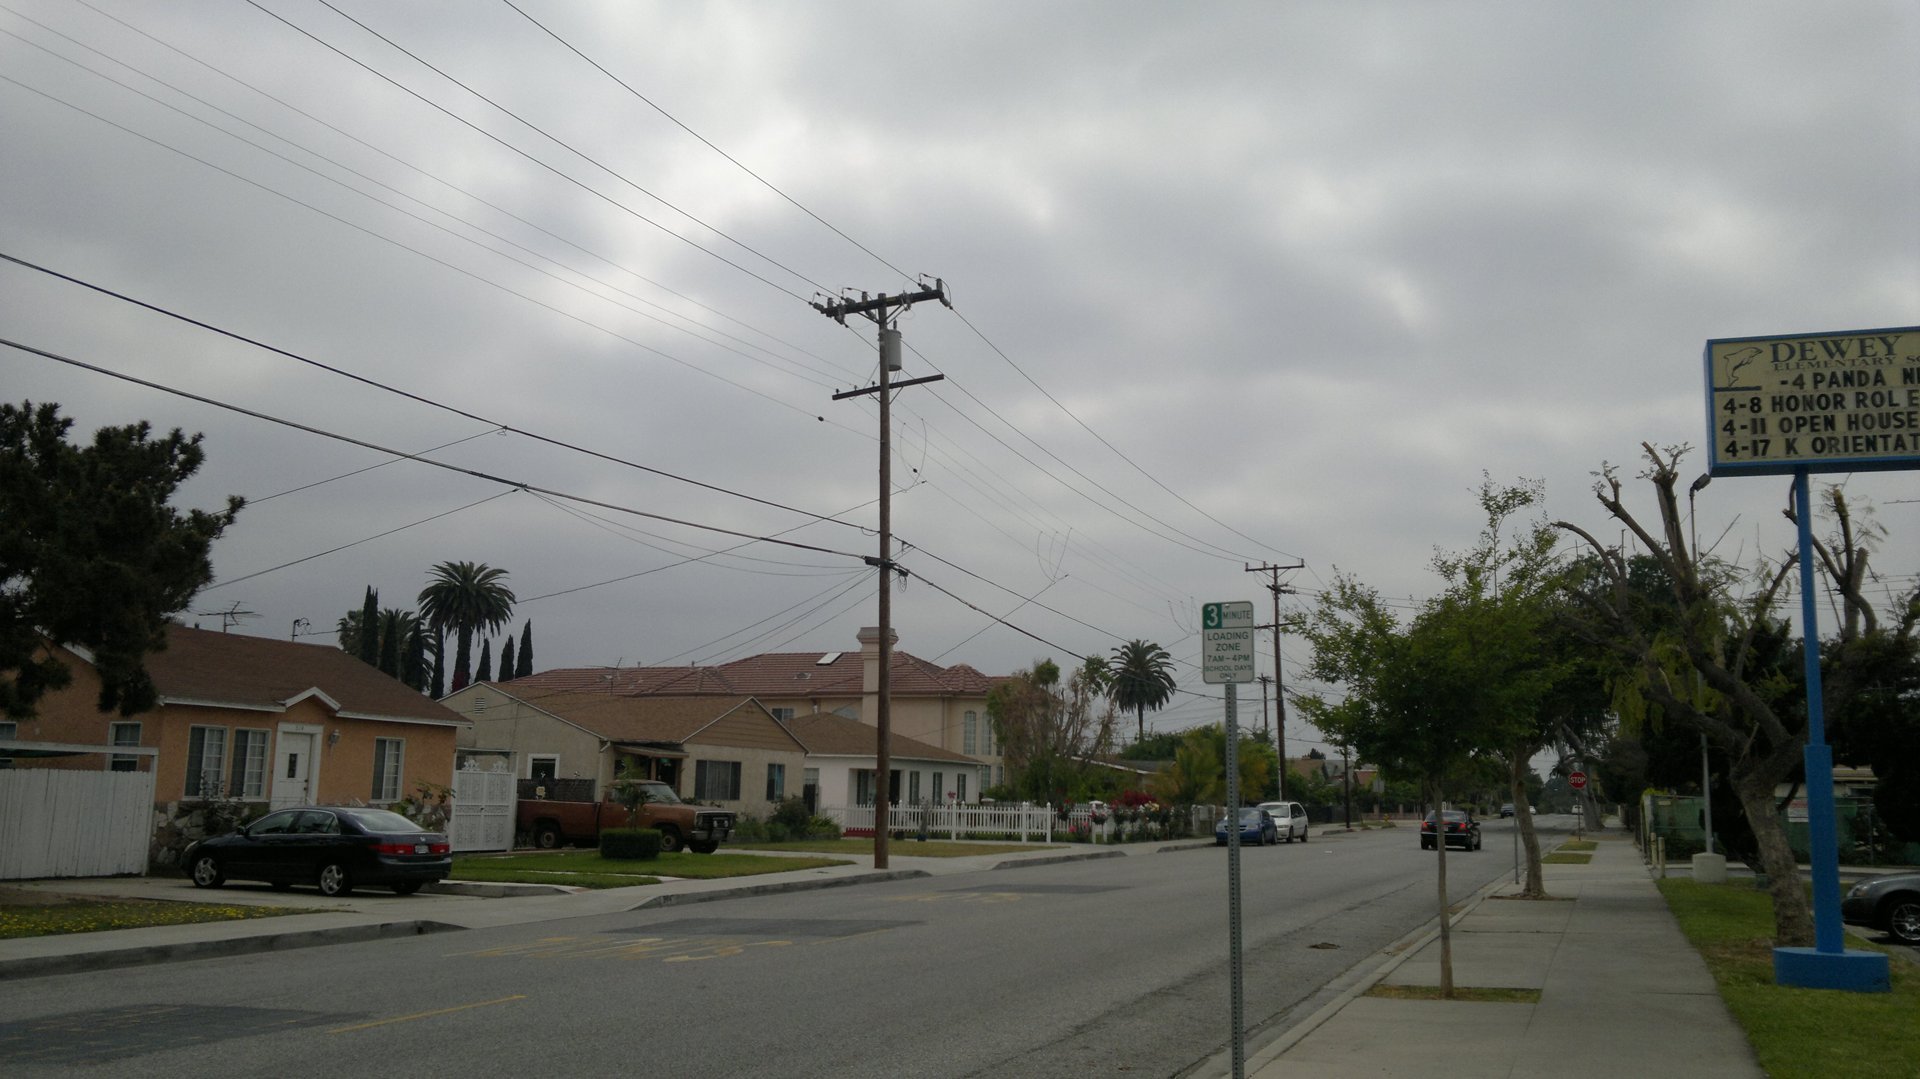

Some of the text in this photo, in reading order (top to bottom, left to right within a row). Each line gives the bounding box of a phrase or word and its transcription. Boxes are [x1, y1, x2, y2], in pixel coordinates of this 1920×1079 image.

[1770, 335, 1902, 363] DEWEY
[1773, 355, 1896, 371] ELEMENTARY
[1813, 368, 1886, 390] PANDA
[1723, 396, 1762, 414] 4-8
[1771, 393, 1846, 413] HONOR
[1722, 411, 1919, 436] 4-11 OPEN HOUSE
[1724, 434, 1920, 457] 4-17 K ORIENTAT
[1207, 605, 1251, 626] 3 MINUTE
[1207, 632, 1249, 641] LOADING
[1215, 643, 1241, 652] ZONE
